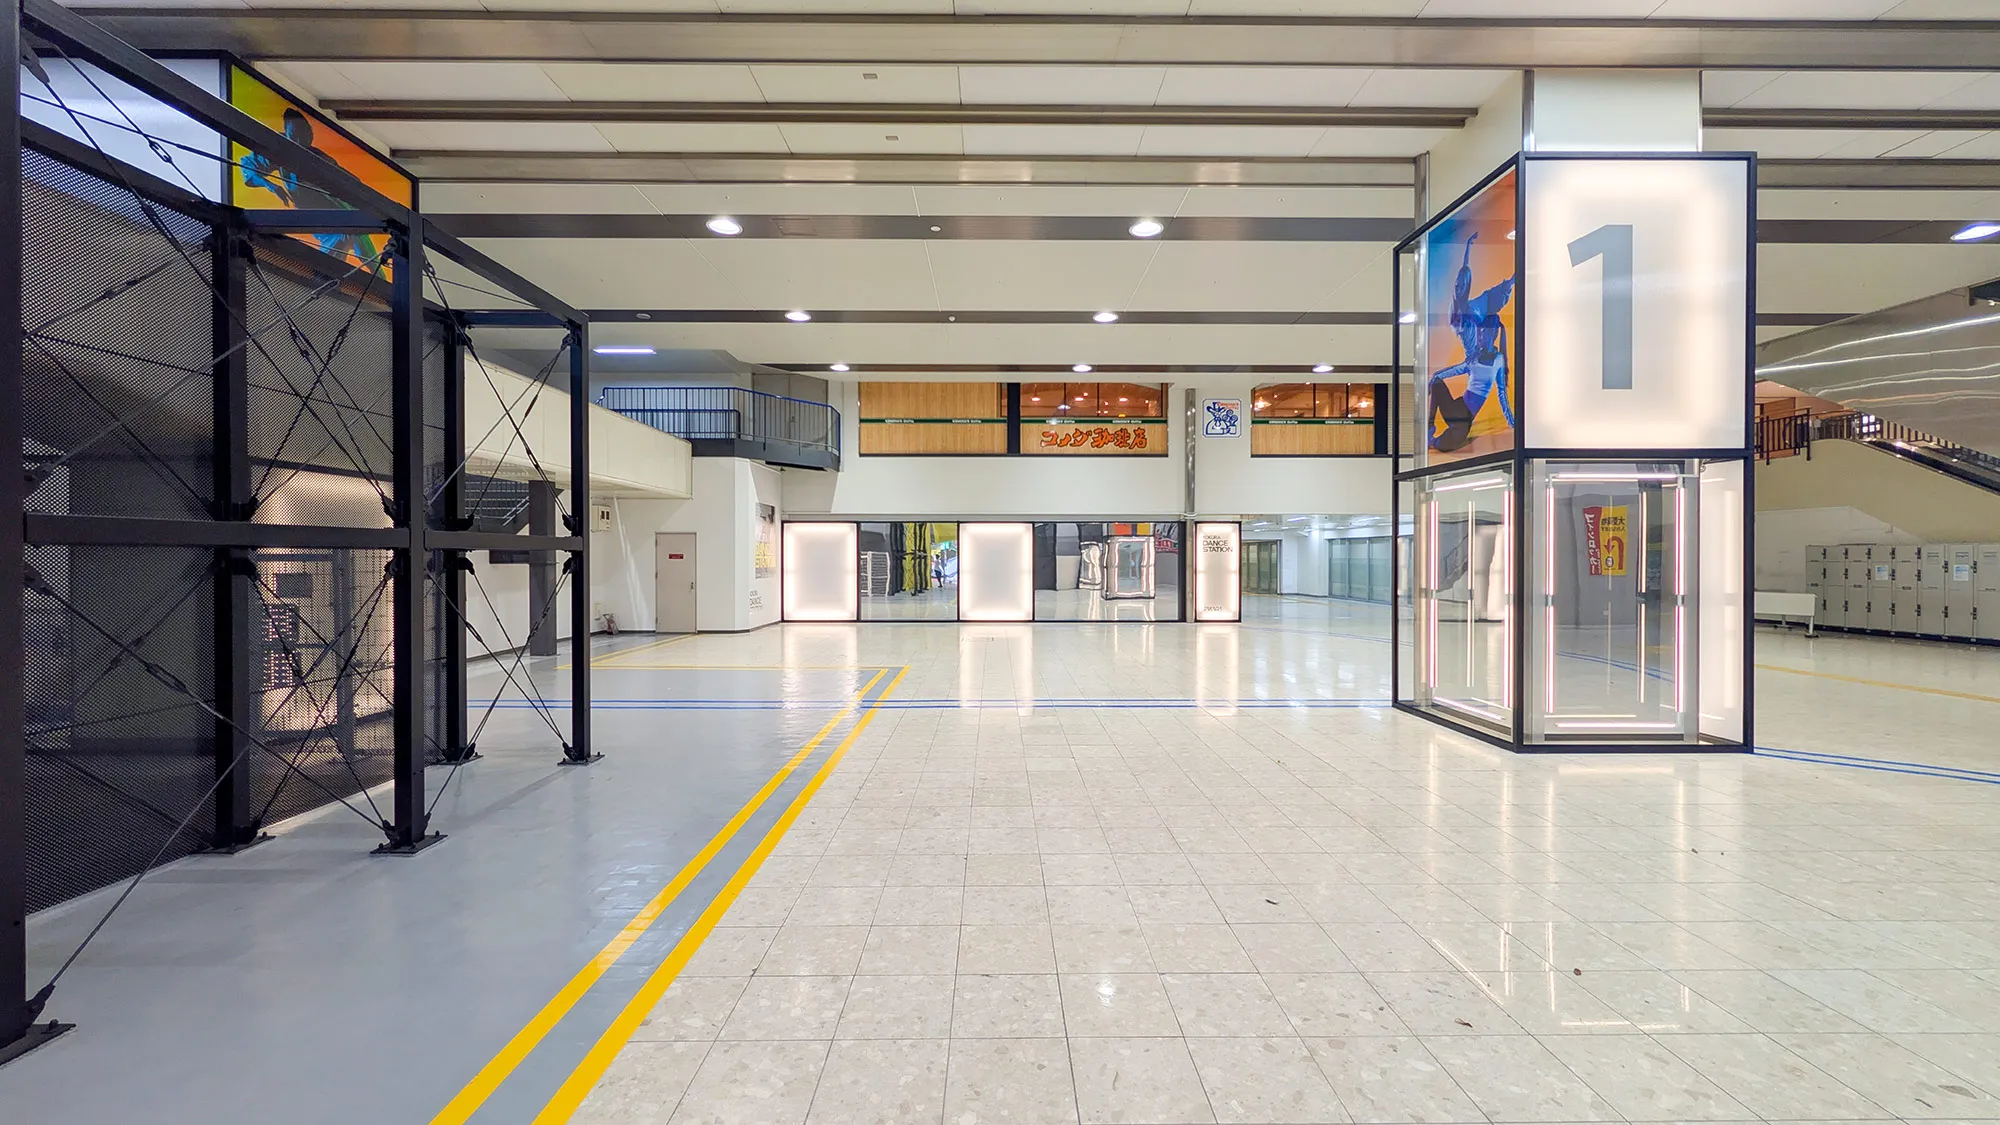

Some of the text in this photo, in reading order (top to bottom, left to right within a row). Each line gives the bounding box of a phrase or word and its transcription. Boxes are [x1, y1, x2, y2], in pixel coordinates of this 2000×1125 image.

[1567, 224, 1633, 390] 1
[1041, 427, 1147, 449] コメダ珈琲店
